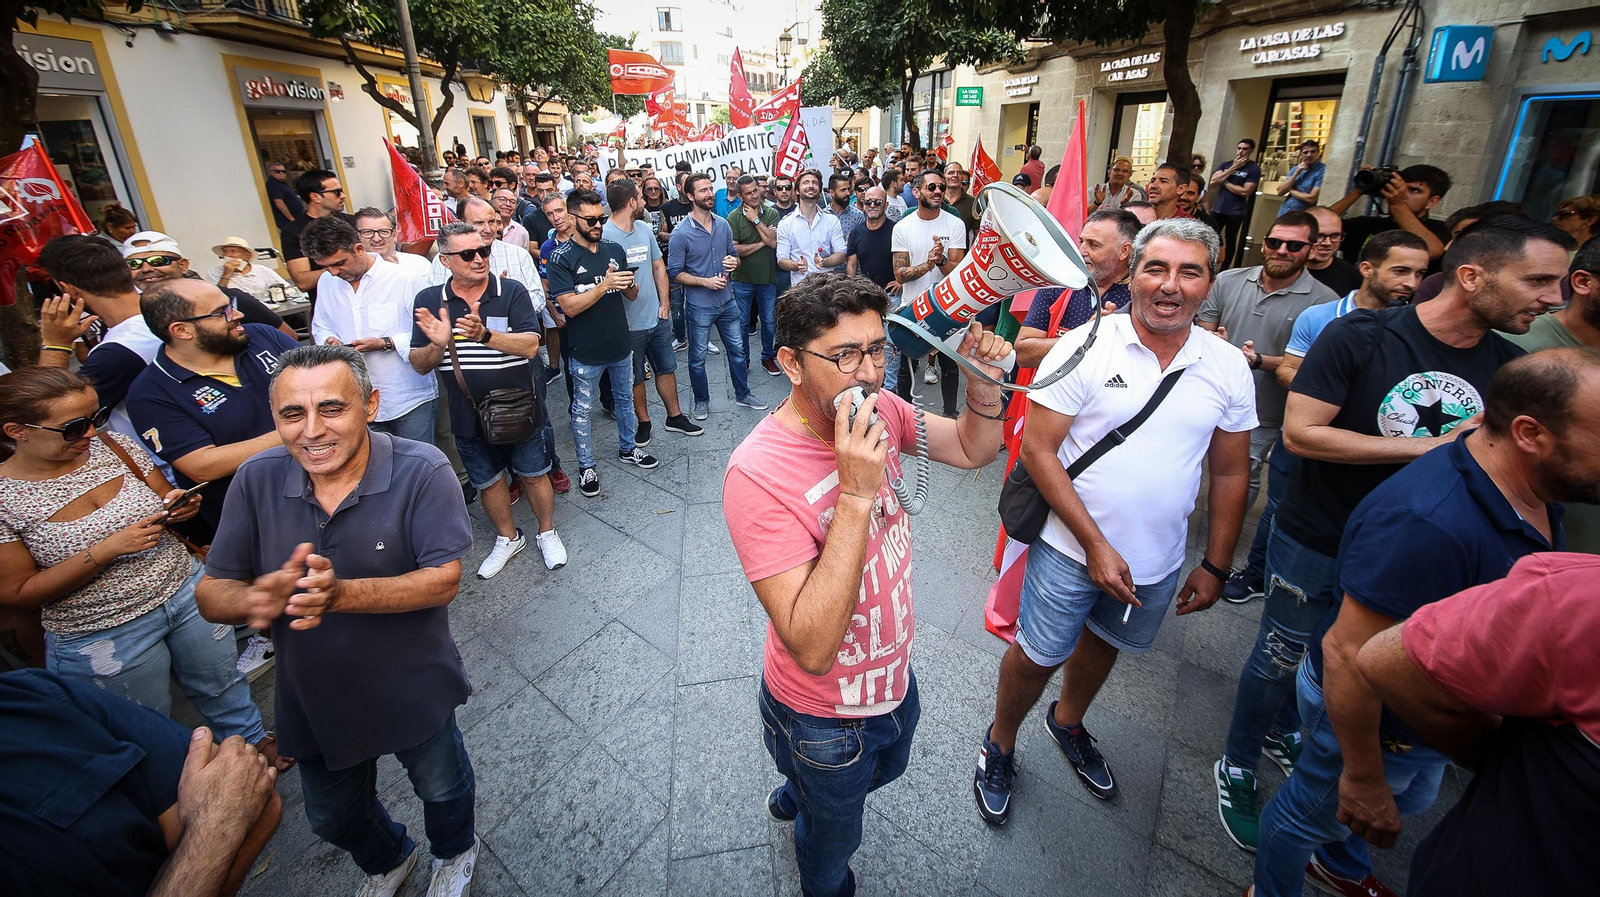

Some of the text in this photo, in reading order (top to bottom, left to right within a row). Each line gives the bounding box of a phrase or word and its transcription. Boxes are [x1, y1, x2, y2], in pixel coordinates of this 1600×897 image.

[1239, 37, 1257, 51] LA
[1257, 31, 1291, 48] CASA
[1311, 21, 1345, 40] LAS
[16, 44, 96, 75] ision
[1100, 62, 1111, 72] LA
[1111, 58, 1131, 69] CASA
[963, 268, 999, 303] CCOO
[1402, 379, 1478, 416] CONVERSE
[1387, 412, 1419, 426] Chuck
[142, 427, 163, 454] 7
